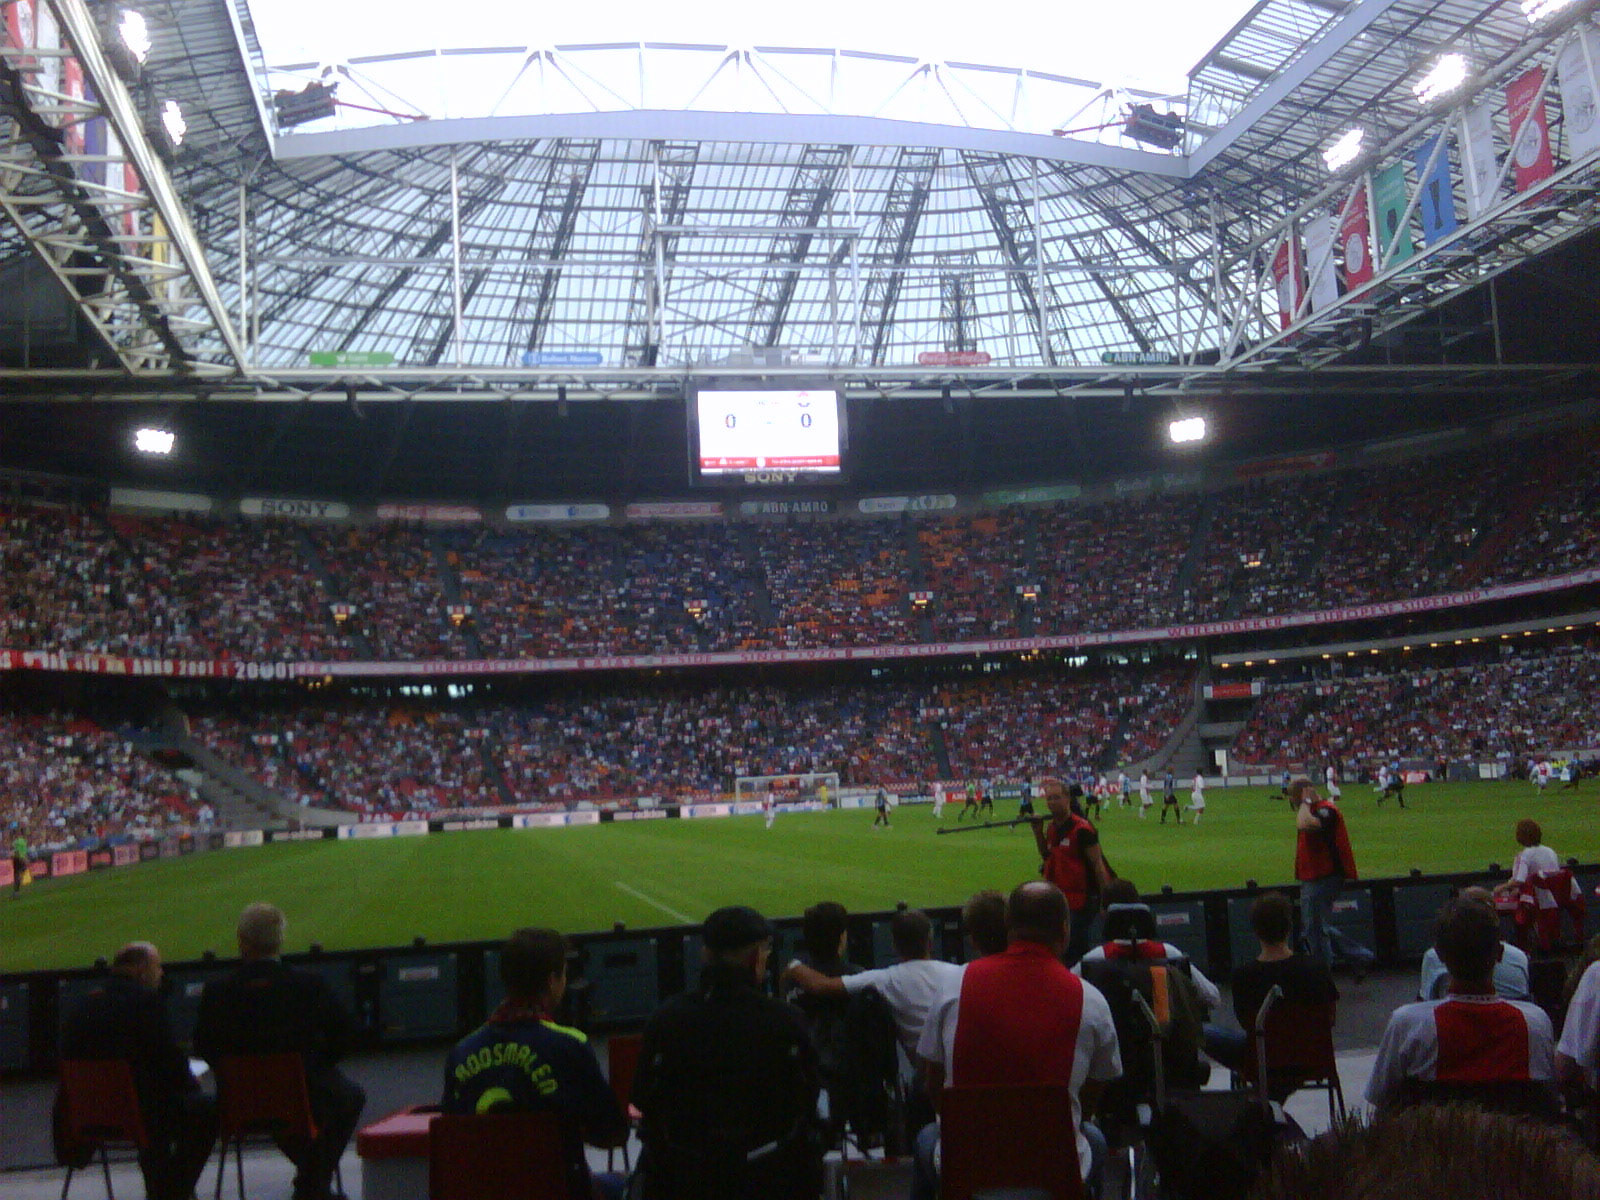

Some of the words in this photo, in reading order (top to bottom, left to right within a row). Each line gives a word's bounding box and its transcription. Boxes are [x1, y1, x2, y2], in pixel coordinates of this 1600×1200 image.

[725, 413, 737, 429] 0
[801, 413, 812, 428] 0
[743, 471, 799, 484] SONY
[262, 500, 330, 516] SONY
[1401, 590, 1482, 612] SUPERCUP
[917, 642, 949, 655] CUP
